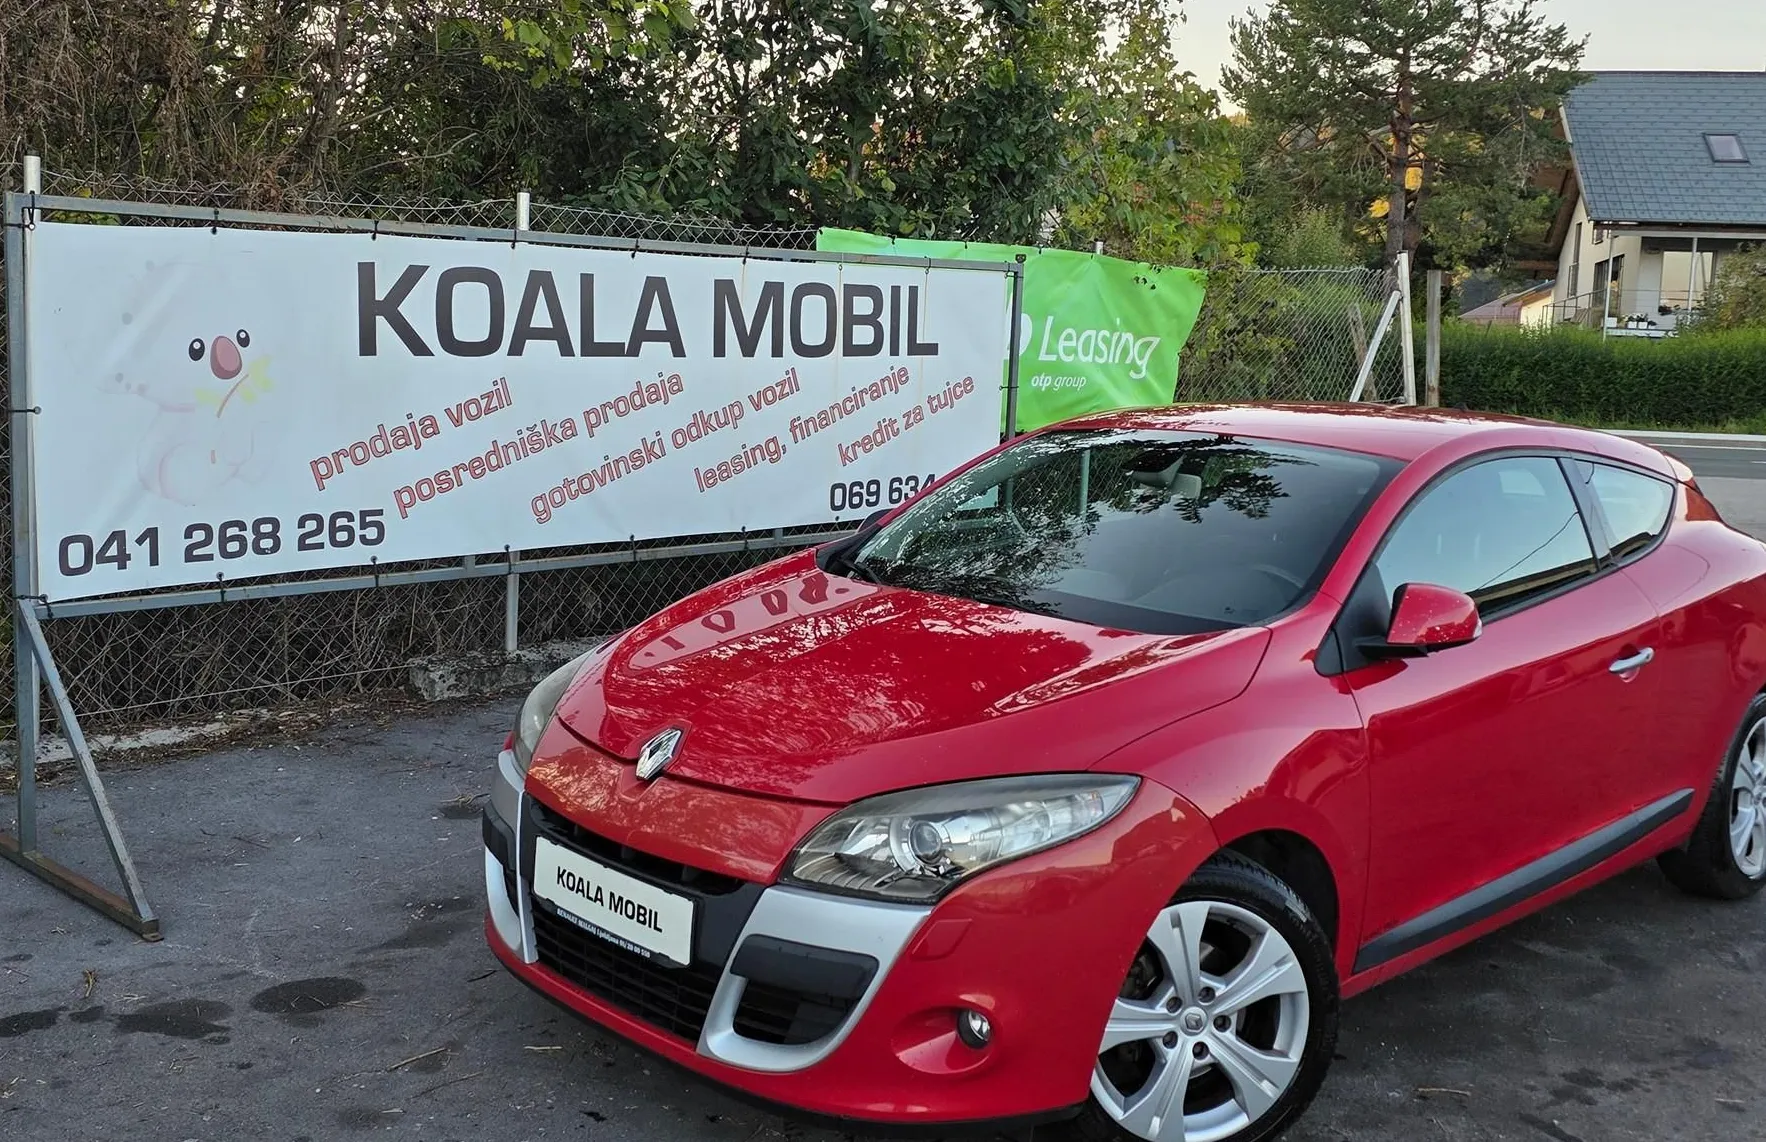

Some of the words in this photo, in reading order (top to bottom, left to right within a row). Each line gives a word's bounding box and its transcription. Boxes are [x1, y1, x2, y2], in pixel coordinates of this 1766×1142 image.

[357, 261, 687, 358] KOALA
[713, 278, 939, 358] MOBIL
[1038, 315, 1161, 379] Leasing
[837, 417, 900, 467] kredit
[902, 405, 924, 431] za
[927, 375, 975, 415] tujce
[1031, 373, 1052, 391] otp
[1053, 374, 1087, 392] group
[309, 412, 441, 492] prodaja
[444, 376, 512, 428] vozil
[393, 417, 579, 519] posredniška
[582, 371, 684, 438] prodaja
[530, 430, 667, 525] gotovinski
[671, 400, 745, 449] odkup
[748, 366, 801, 412] vozil
[693, 436, 787, 493] leasing,
[789, 365, 910, 444] financiranje
[830, 479, 881, 512] 069
[58, 526, 160, 577] 041
[183, 516, 282, 564] 268
[296, 508, 386, 553] 265
[556, 865, 605, 907] KOALA
[608, 891, 663, 934] MOBIL
